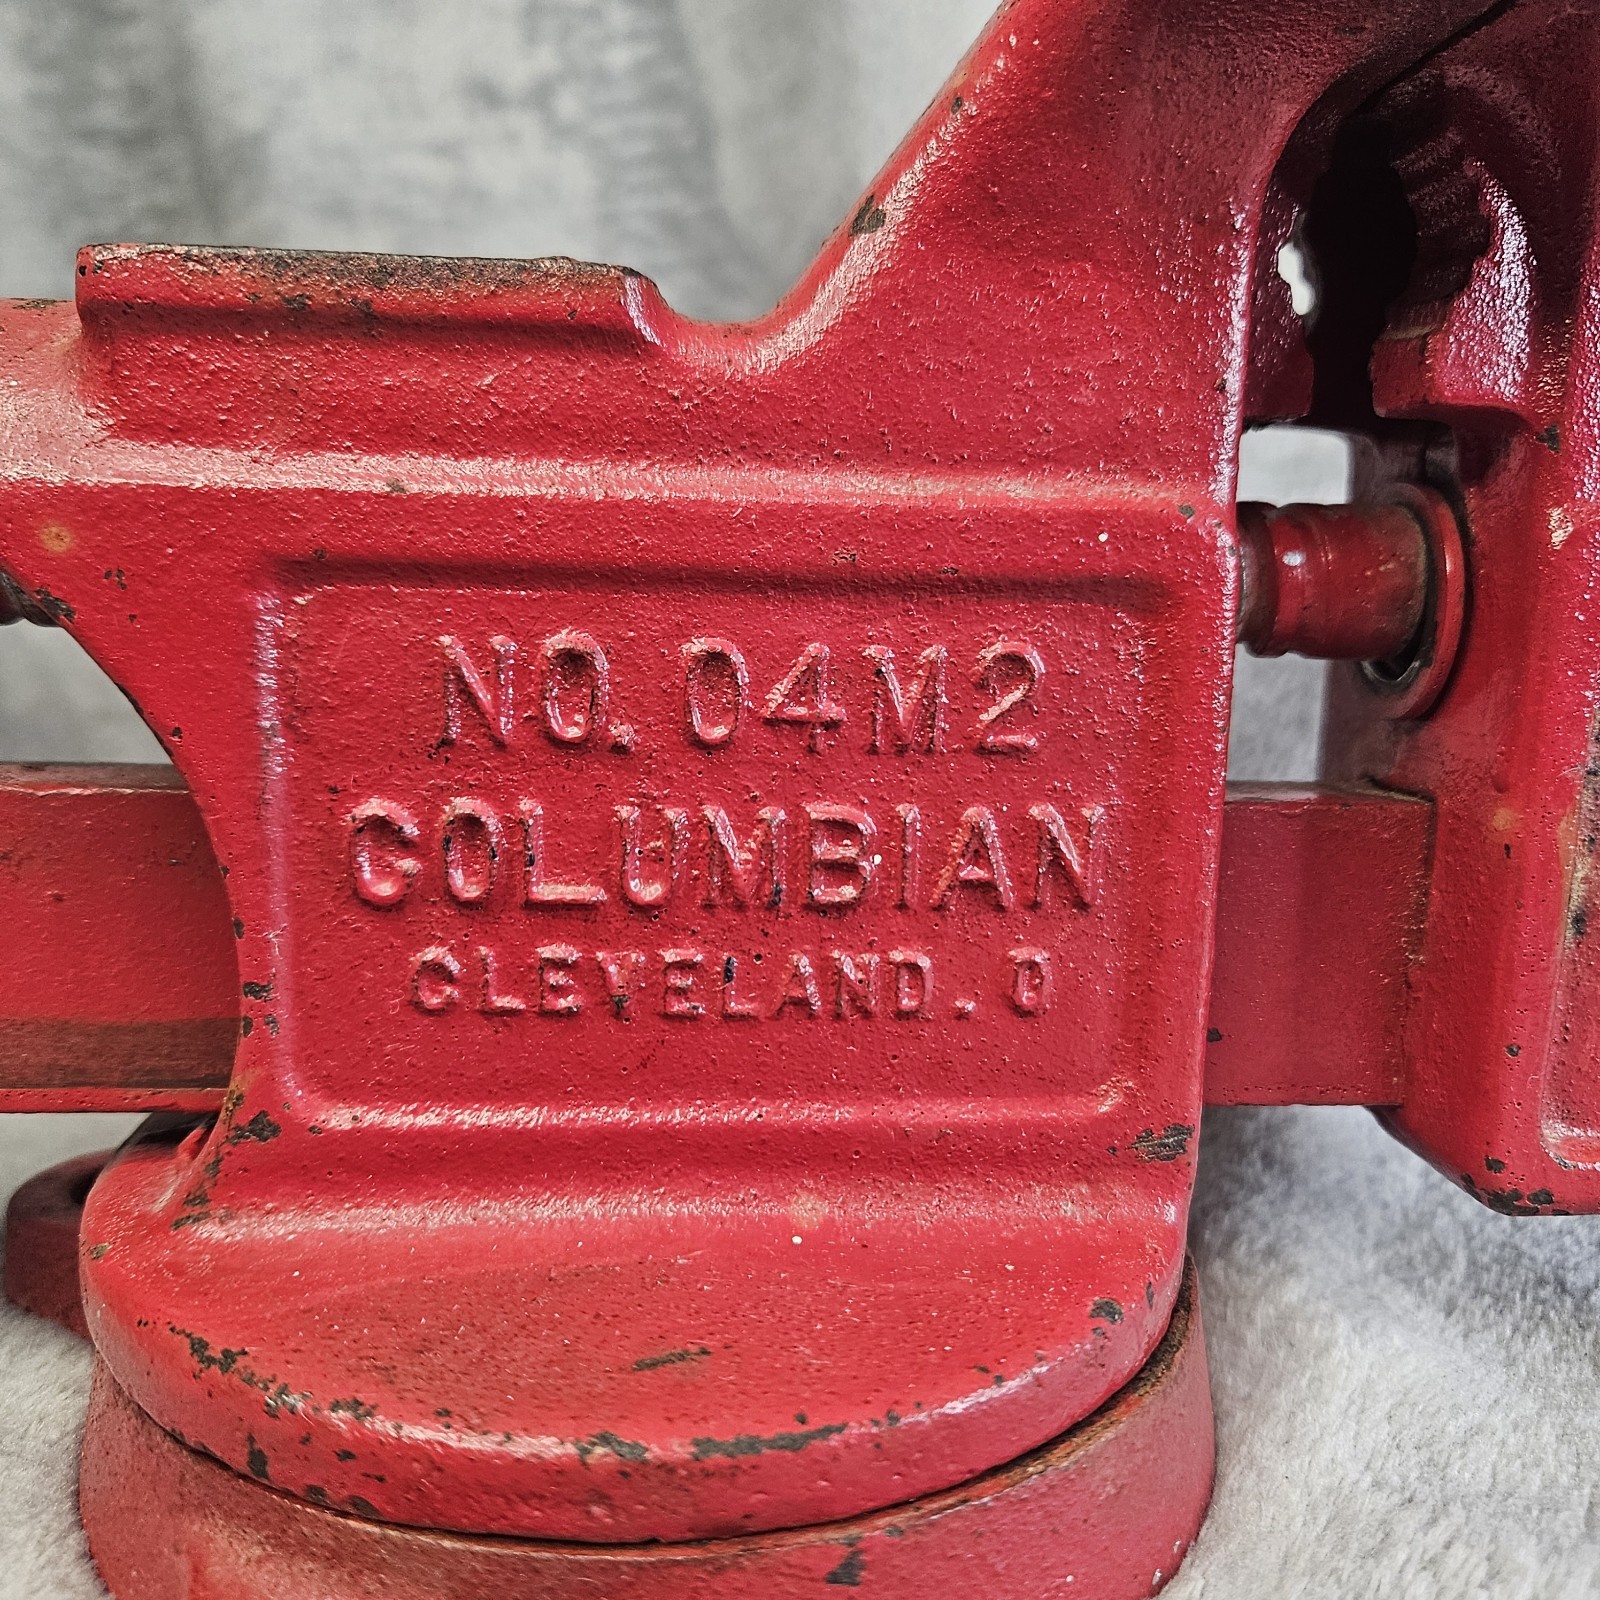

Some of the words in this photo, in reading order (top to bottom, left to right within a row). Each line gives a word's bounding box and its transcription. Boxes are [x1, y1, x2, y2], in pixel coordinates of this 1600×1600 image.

[438, 628, 638, 751] NO.
[680, 636, 1045, 754] 04M2
[346, 797, 1105, 911] COLUMBIAN
